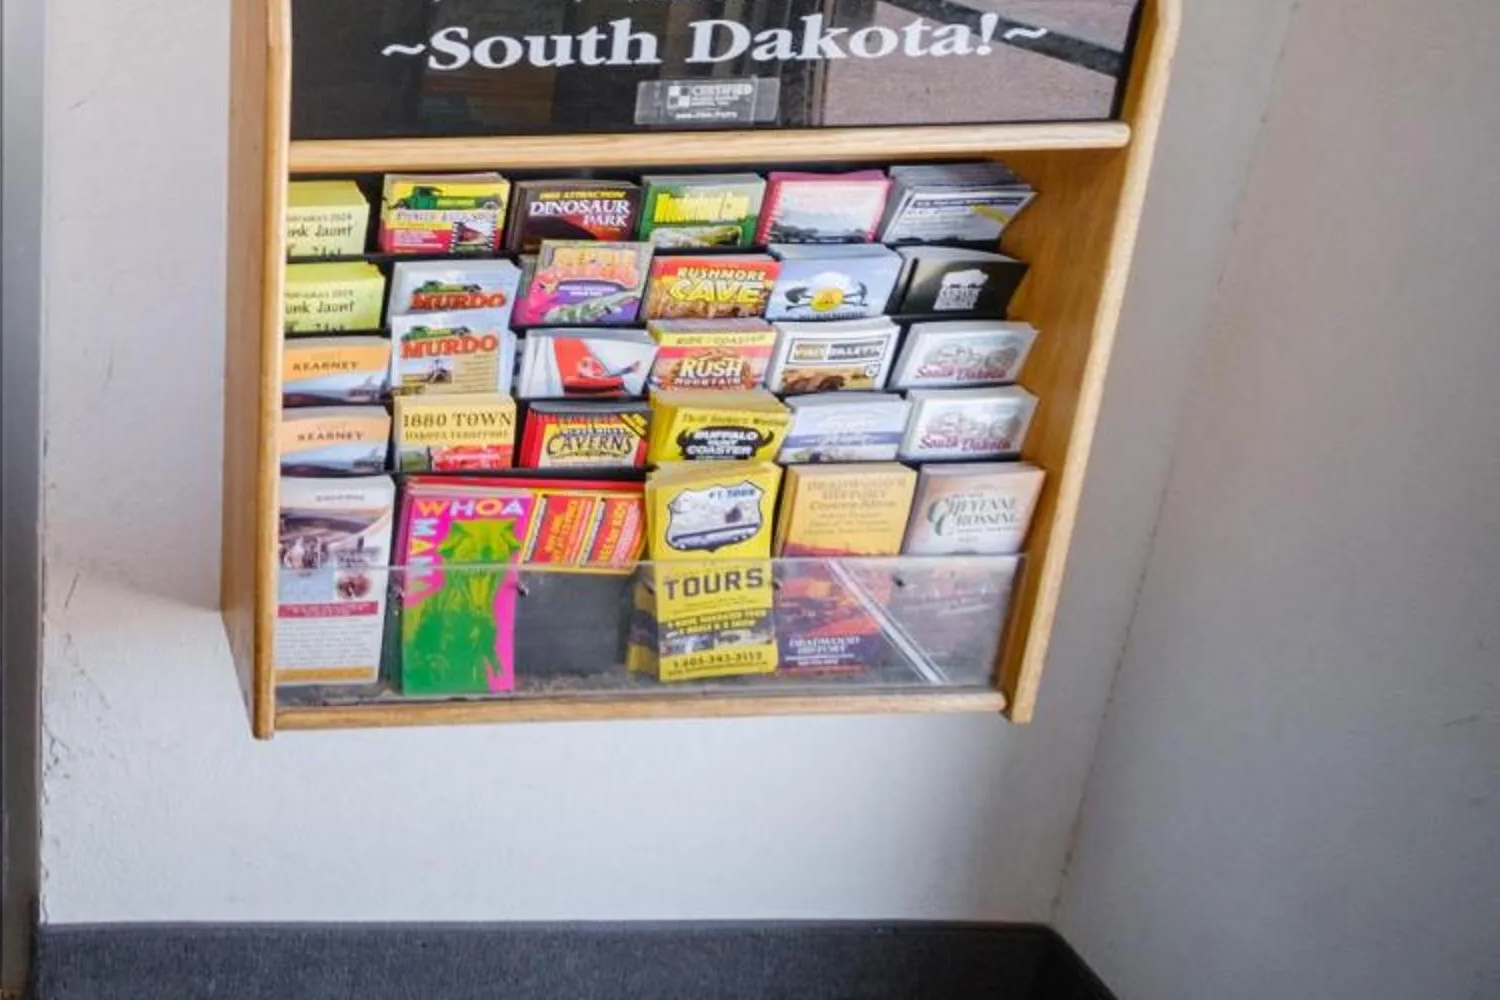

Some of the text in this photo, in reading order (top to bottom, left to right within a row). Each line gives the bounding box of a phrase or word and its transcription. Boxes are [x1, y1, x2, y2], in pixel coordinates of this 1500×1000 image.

[529, 199, 630, 217] DINOSAUR
[583, 215, 627, 227] PARK
[287, 225, 308, 237] unk
[676, 267, 767, 281] RUSHMORE
[411, 291, 506, 310] MURDO
[669, 279, 765, 304] CAVE
[285, 301, 310, 314] unk
[401, 334, 499, 359] MURDO
[292, 361, 358, 371] KEARNEY
[679, 358, 741, 378] RUSH
[404, 410, 512, 428] 1880 TOWN
[297, 431, 363, 441] KEARNEY
[548, 432, 634, 457] CAVERNS
[685, 444, 752, 455] COASTER
[418, 499, 524, 517] WHOA
[664, 567, 764, 600] TOURS
